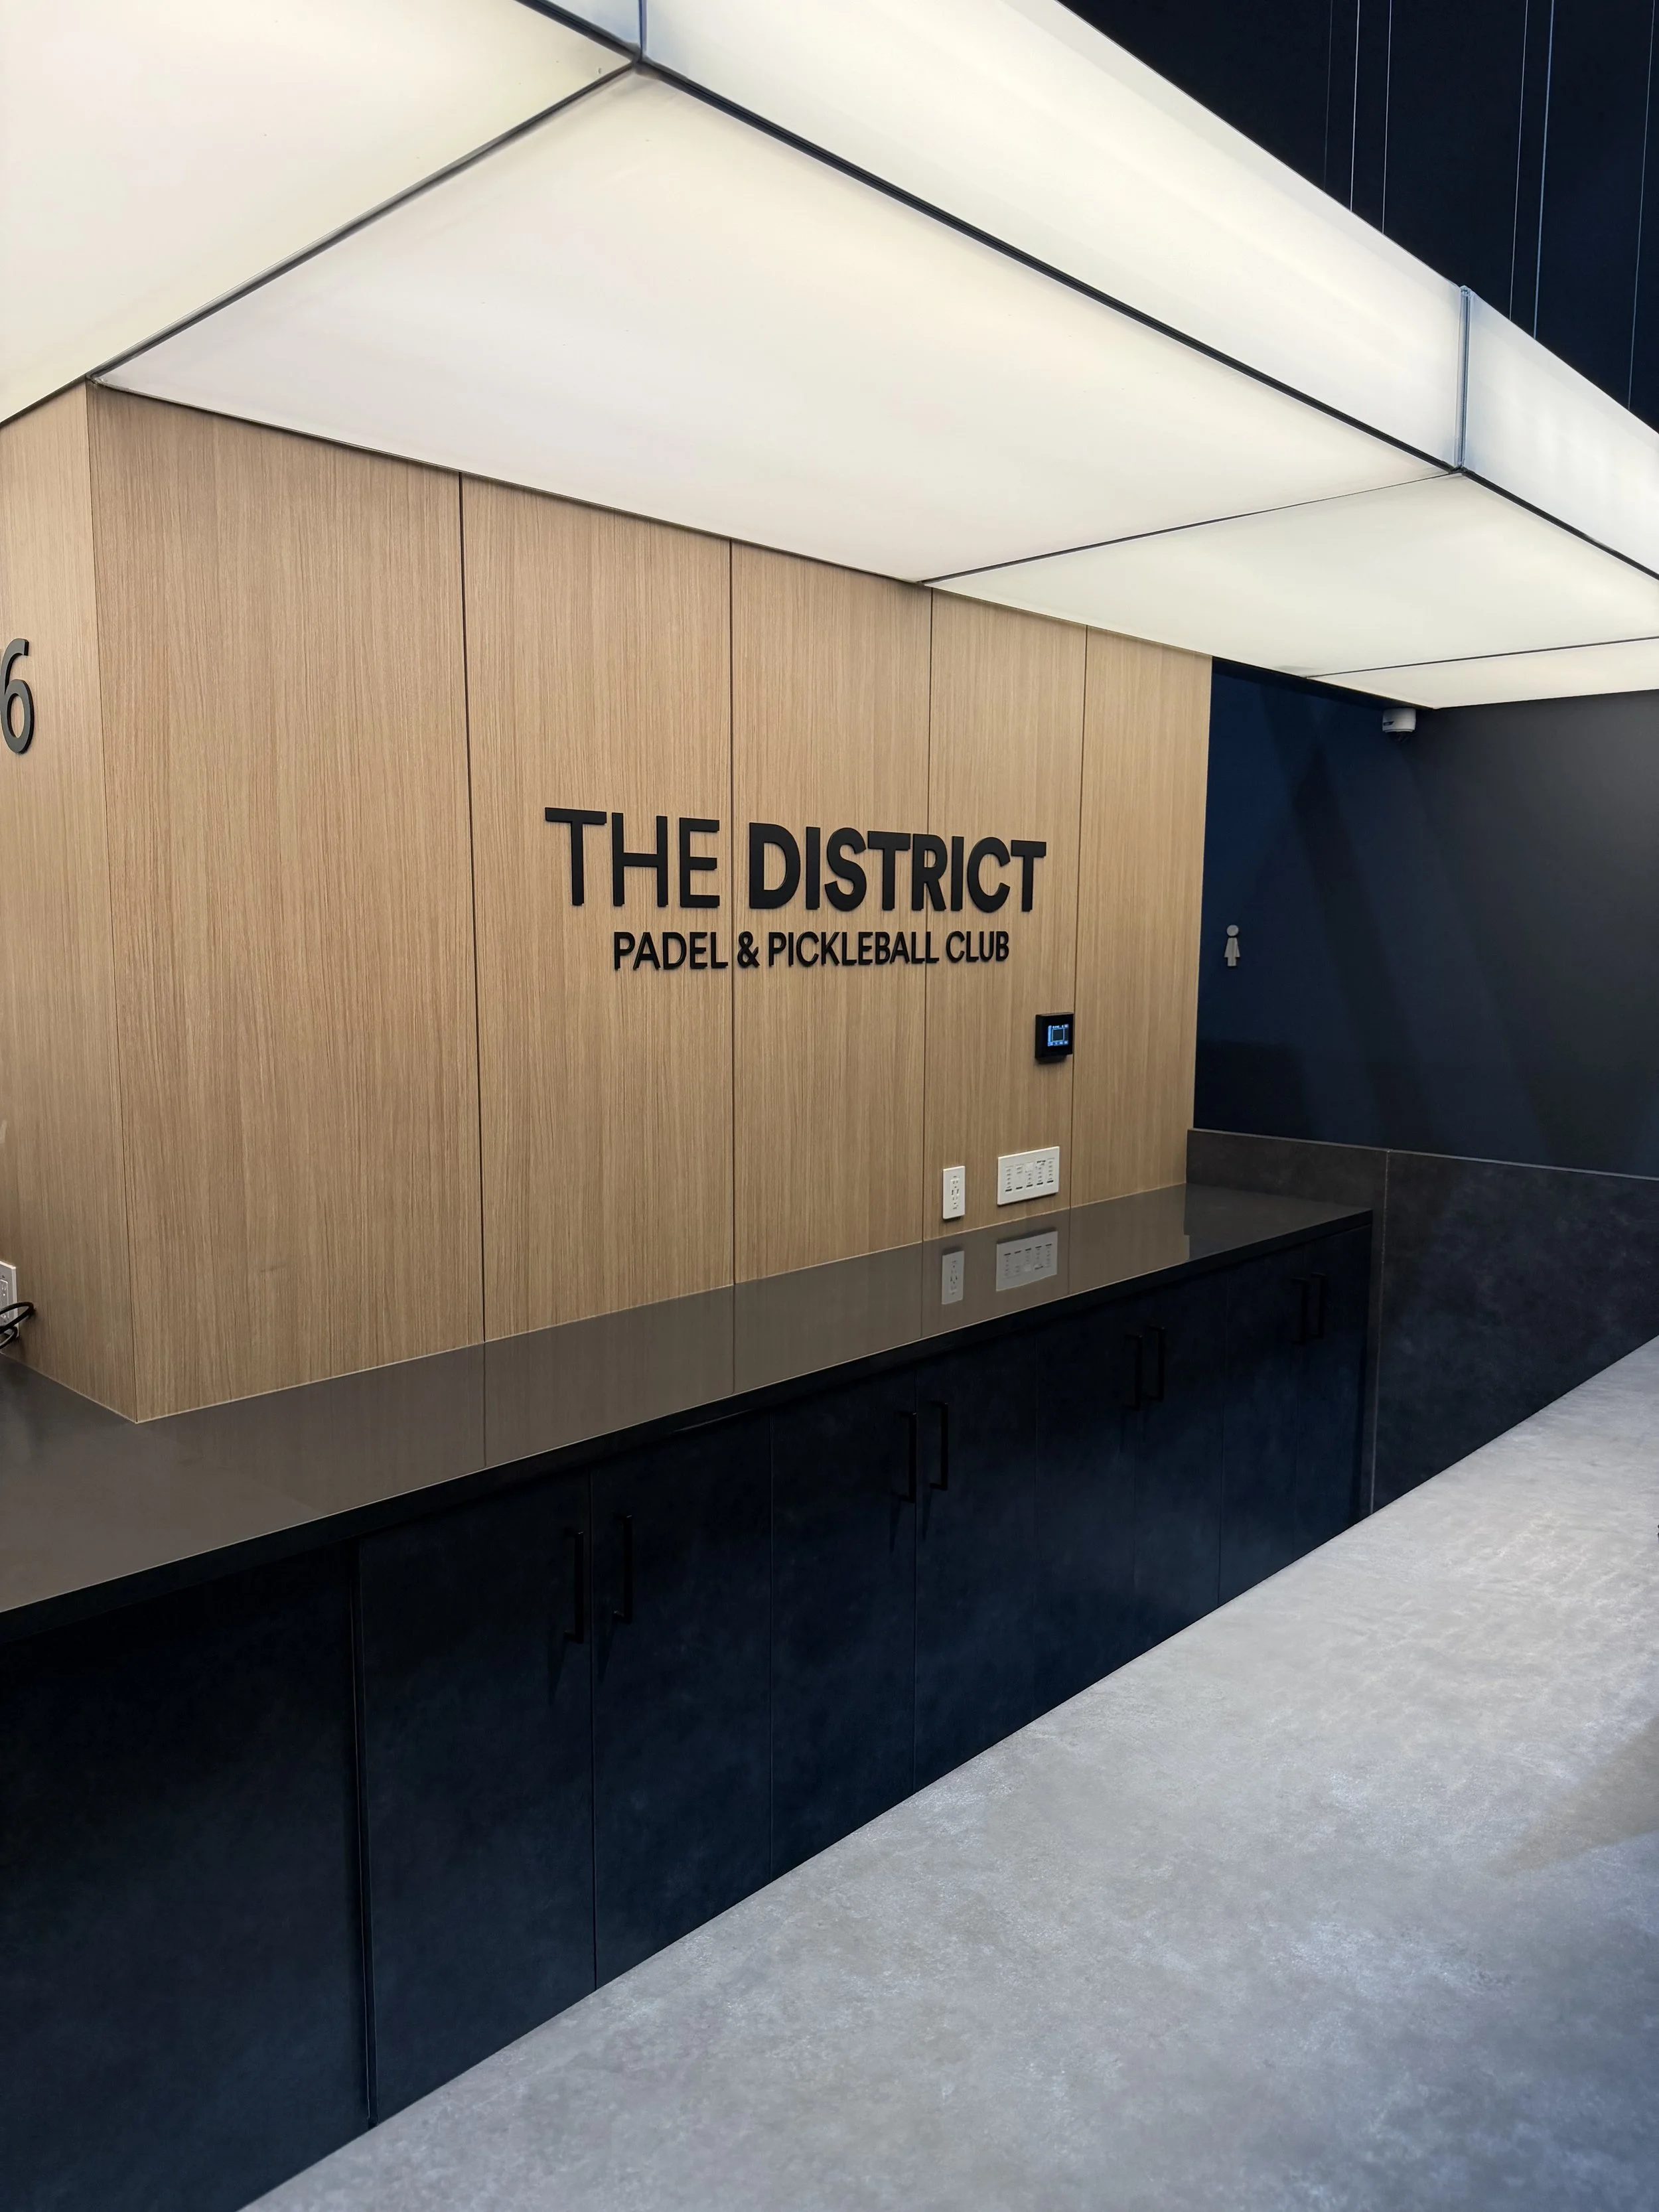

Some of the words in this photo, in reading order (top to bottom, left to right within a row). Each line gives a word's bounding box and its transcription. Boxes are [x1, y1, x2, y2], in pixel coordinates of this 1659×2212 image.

[0, 638, 35, 755] 6
[545, 807, 720, 909] THE
[749, 822, 1047, 913] DISTRICT
[614, 931, 729, 971] PADEL
[737, 930, 760, 969] &
[768, 930, 939, 968] PICKLEBALL
[945, 930, 1009, 964] CLUB
